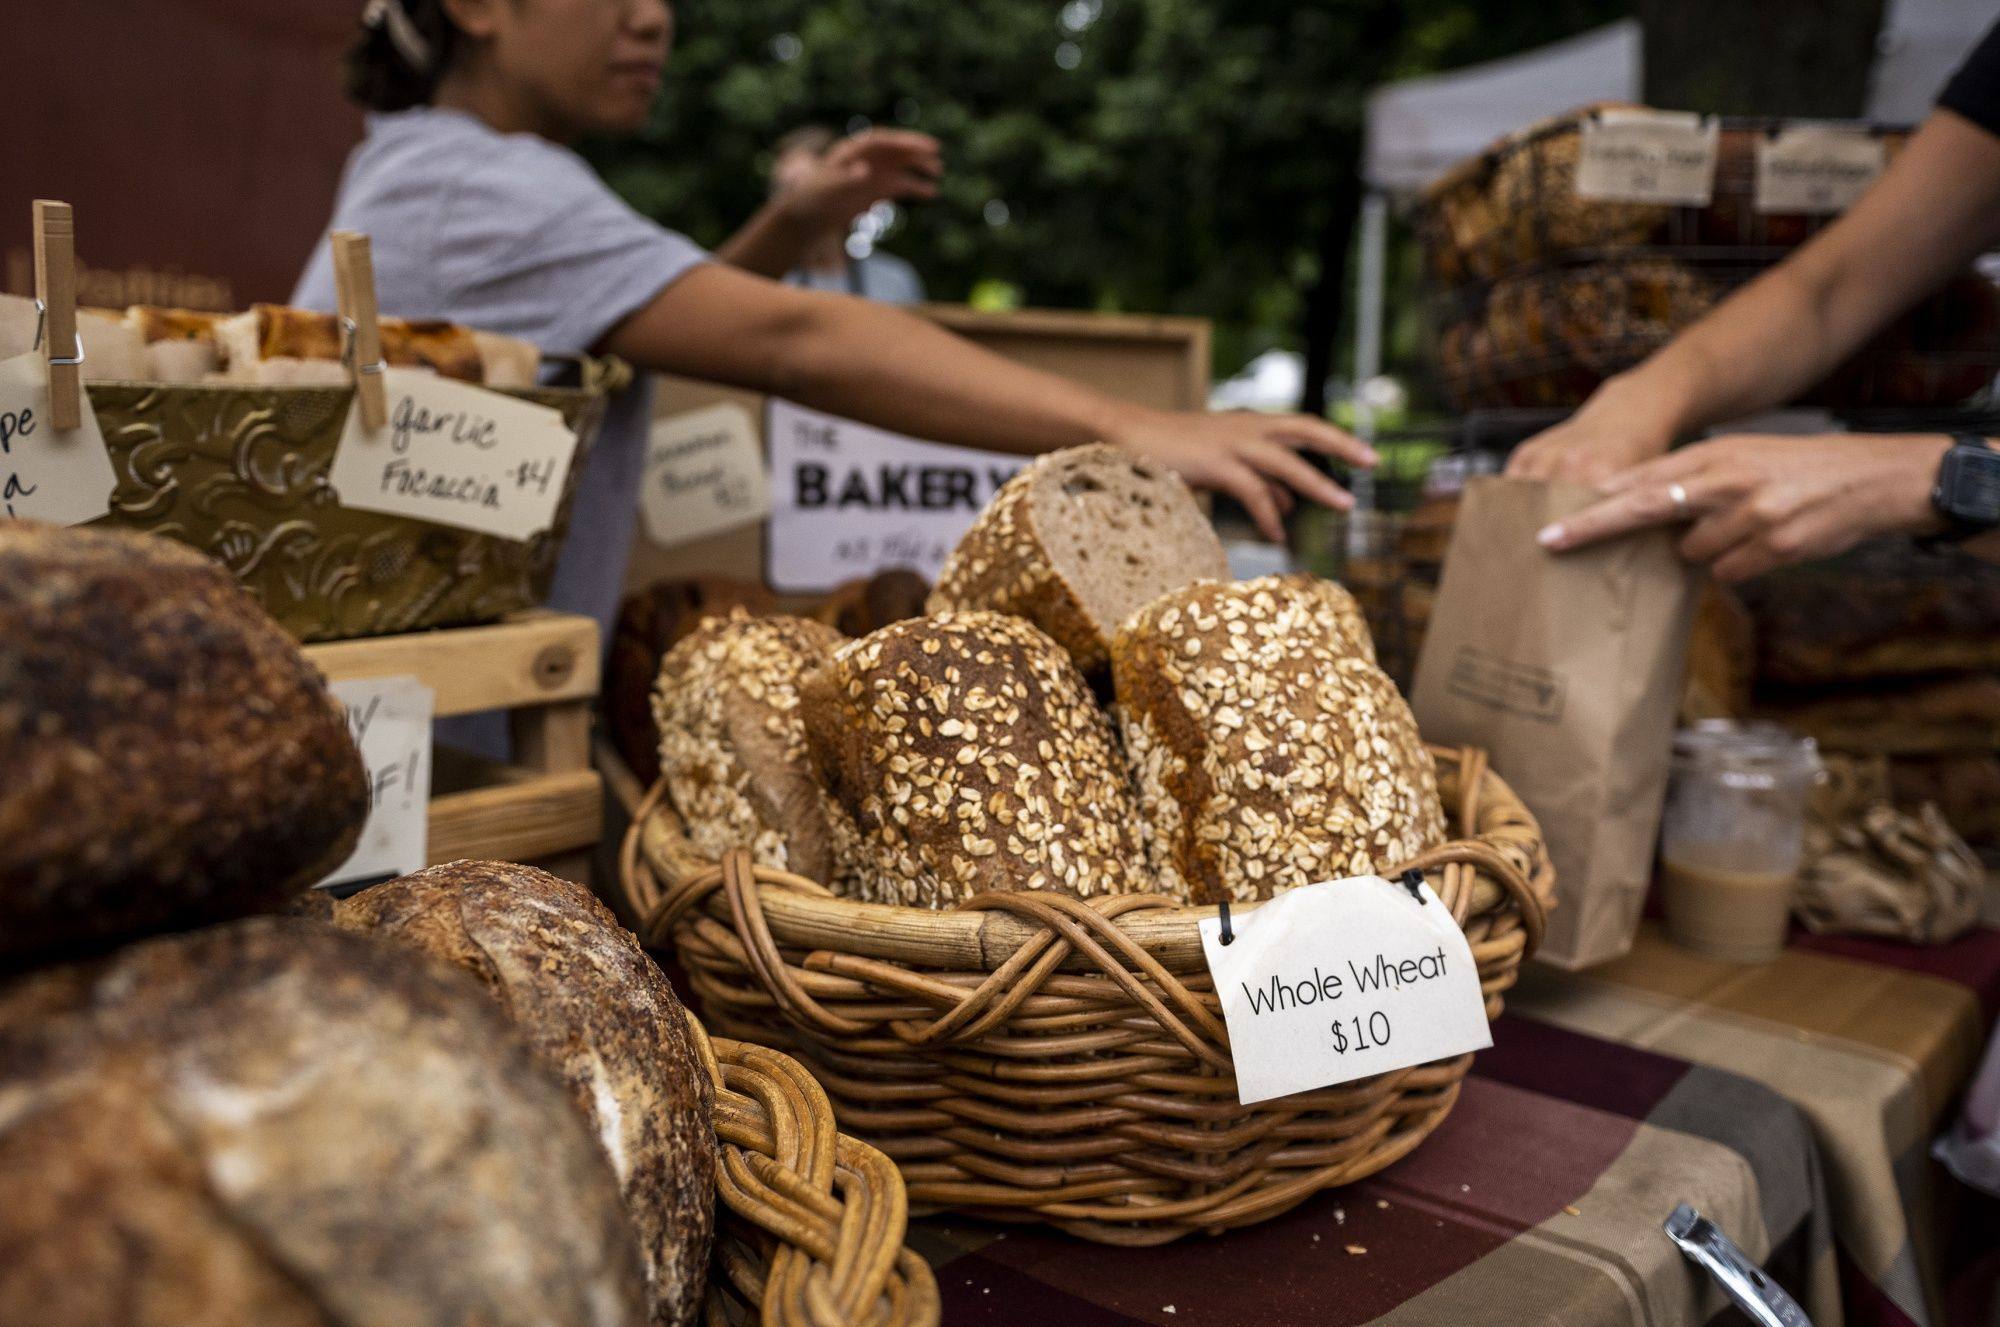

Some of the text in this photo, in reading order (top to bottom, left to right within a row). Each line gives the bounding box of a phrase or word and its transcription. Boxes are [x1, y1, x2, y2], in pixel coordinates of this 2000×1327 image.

[380, 457, 502, 509] Focaccia
[793, 461, 1020, 511] BAKERY
[1241, 946, 1448, 1016] Whole Wheat
[1330, 1010, 1391, 1055] $10
